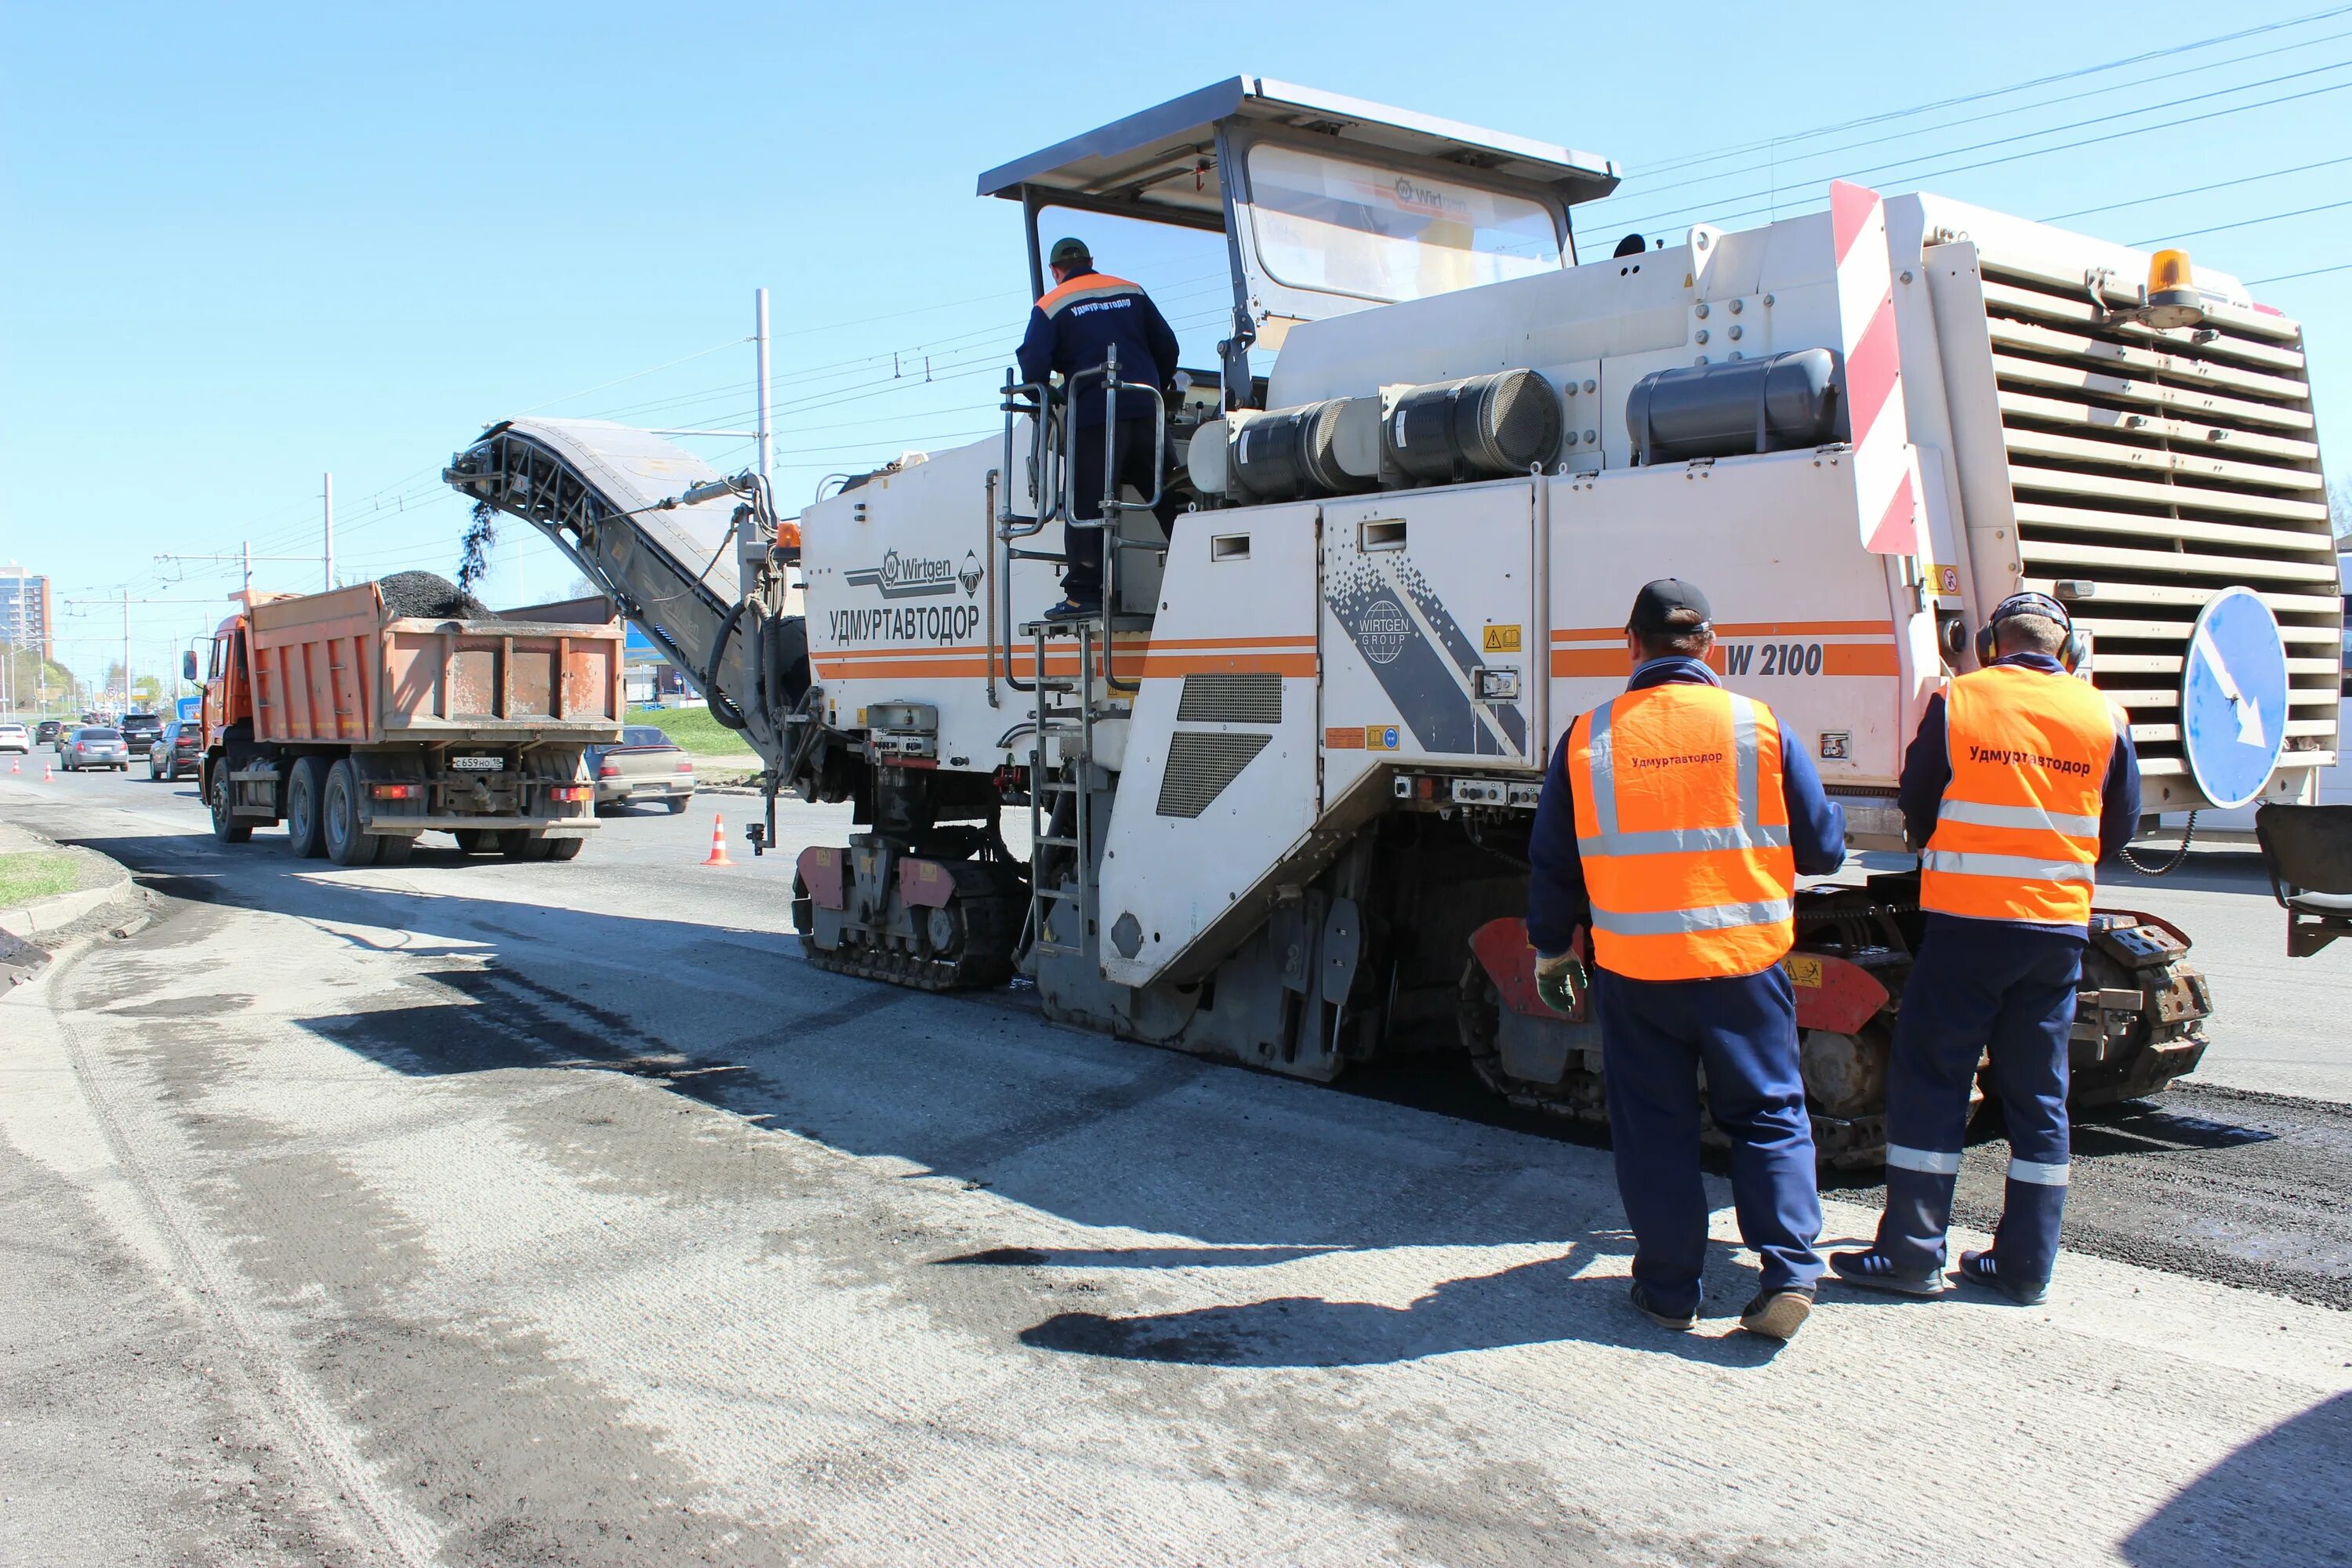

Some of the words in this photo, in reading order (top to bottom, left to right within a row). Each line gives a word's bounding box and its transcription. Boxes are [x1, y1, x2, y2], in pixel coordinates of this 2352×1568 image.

[902, 557, 951, 583] Wirtgen
[829, 605, 979, 646] УДМУРТАВТОДОР
[1359, 618, 1409, 632] WIRTGEN
[1362, 634, 1405, 645] GROUP
[1727, 644, 1754, 676] W
[1759, 644, 1822, 676] 2100
[1632, 753, 1722, 769] Удмуртавтодор
[1969, 746, 2091, 777] Удмуртавтодор
